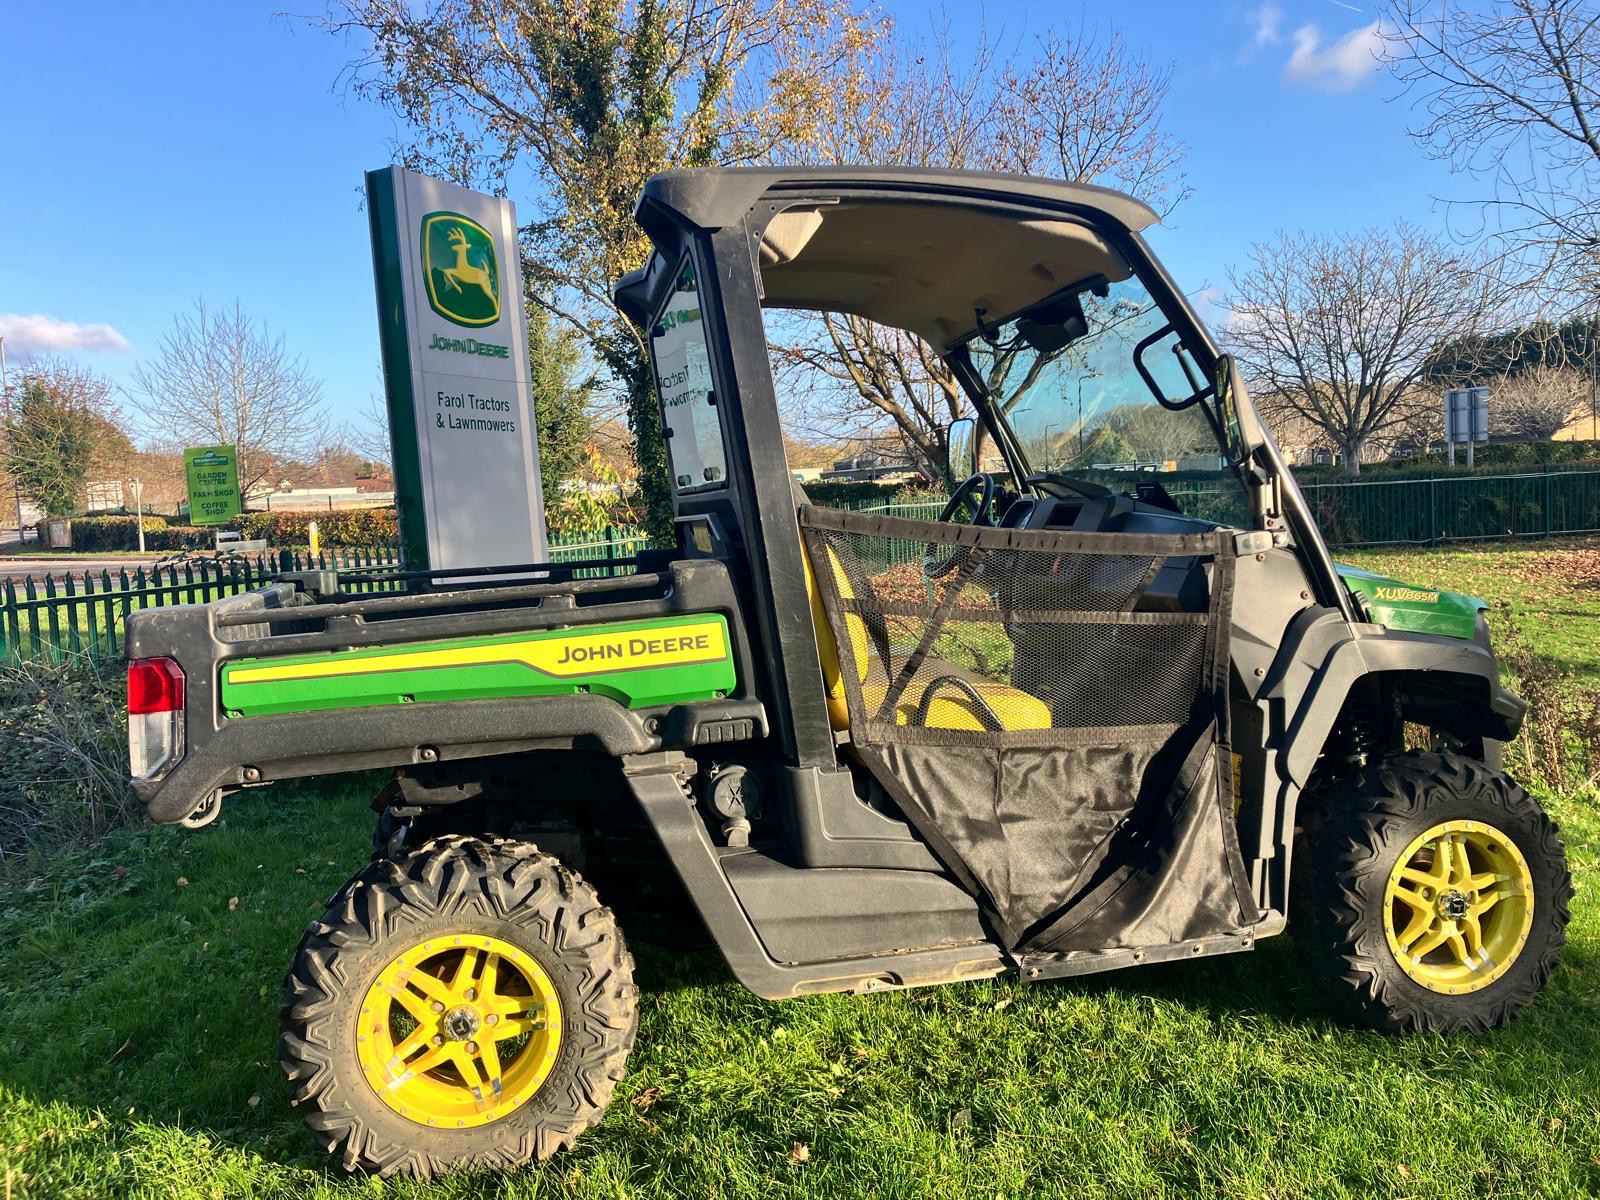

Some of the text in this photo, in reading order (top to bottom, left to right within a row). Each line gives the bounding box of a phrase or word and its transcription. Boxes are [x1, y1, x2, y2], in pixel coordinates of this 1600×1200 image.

[429, 334, 509, 358] JOHN DEERE
[437, 392, 509, 411] Farol Tractors
[436, 413, 514, 431] & Lawnmowers
[197, 472, 227, 480] GARDEN
[557, 635, 709, 664] JOHN DEERE
